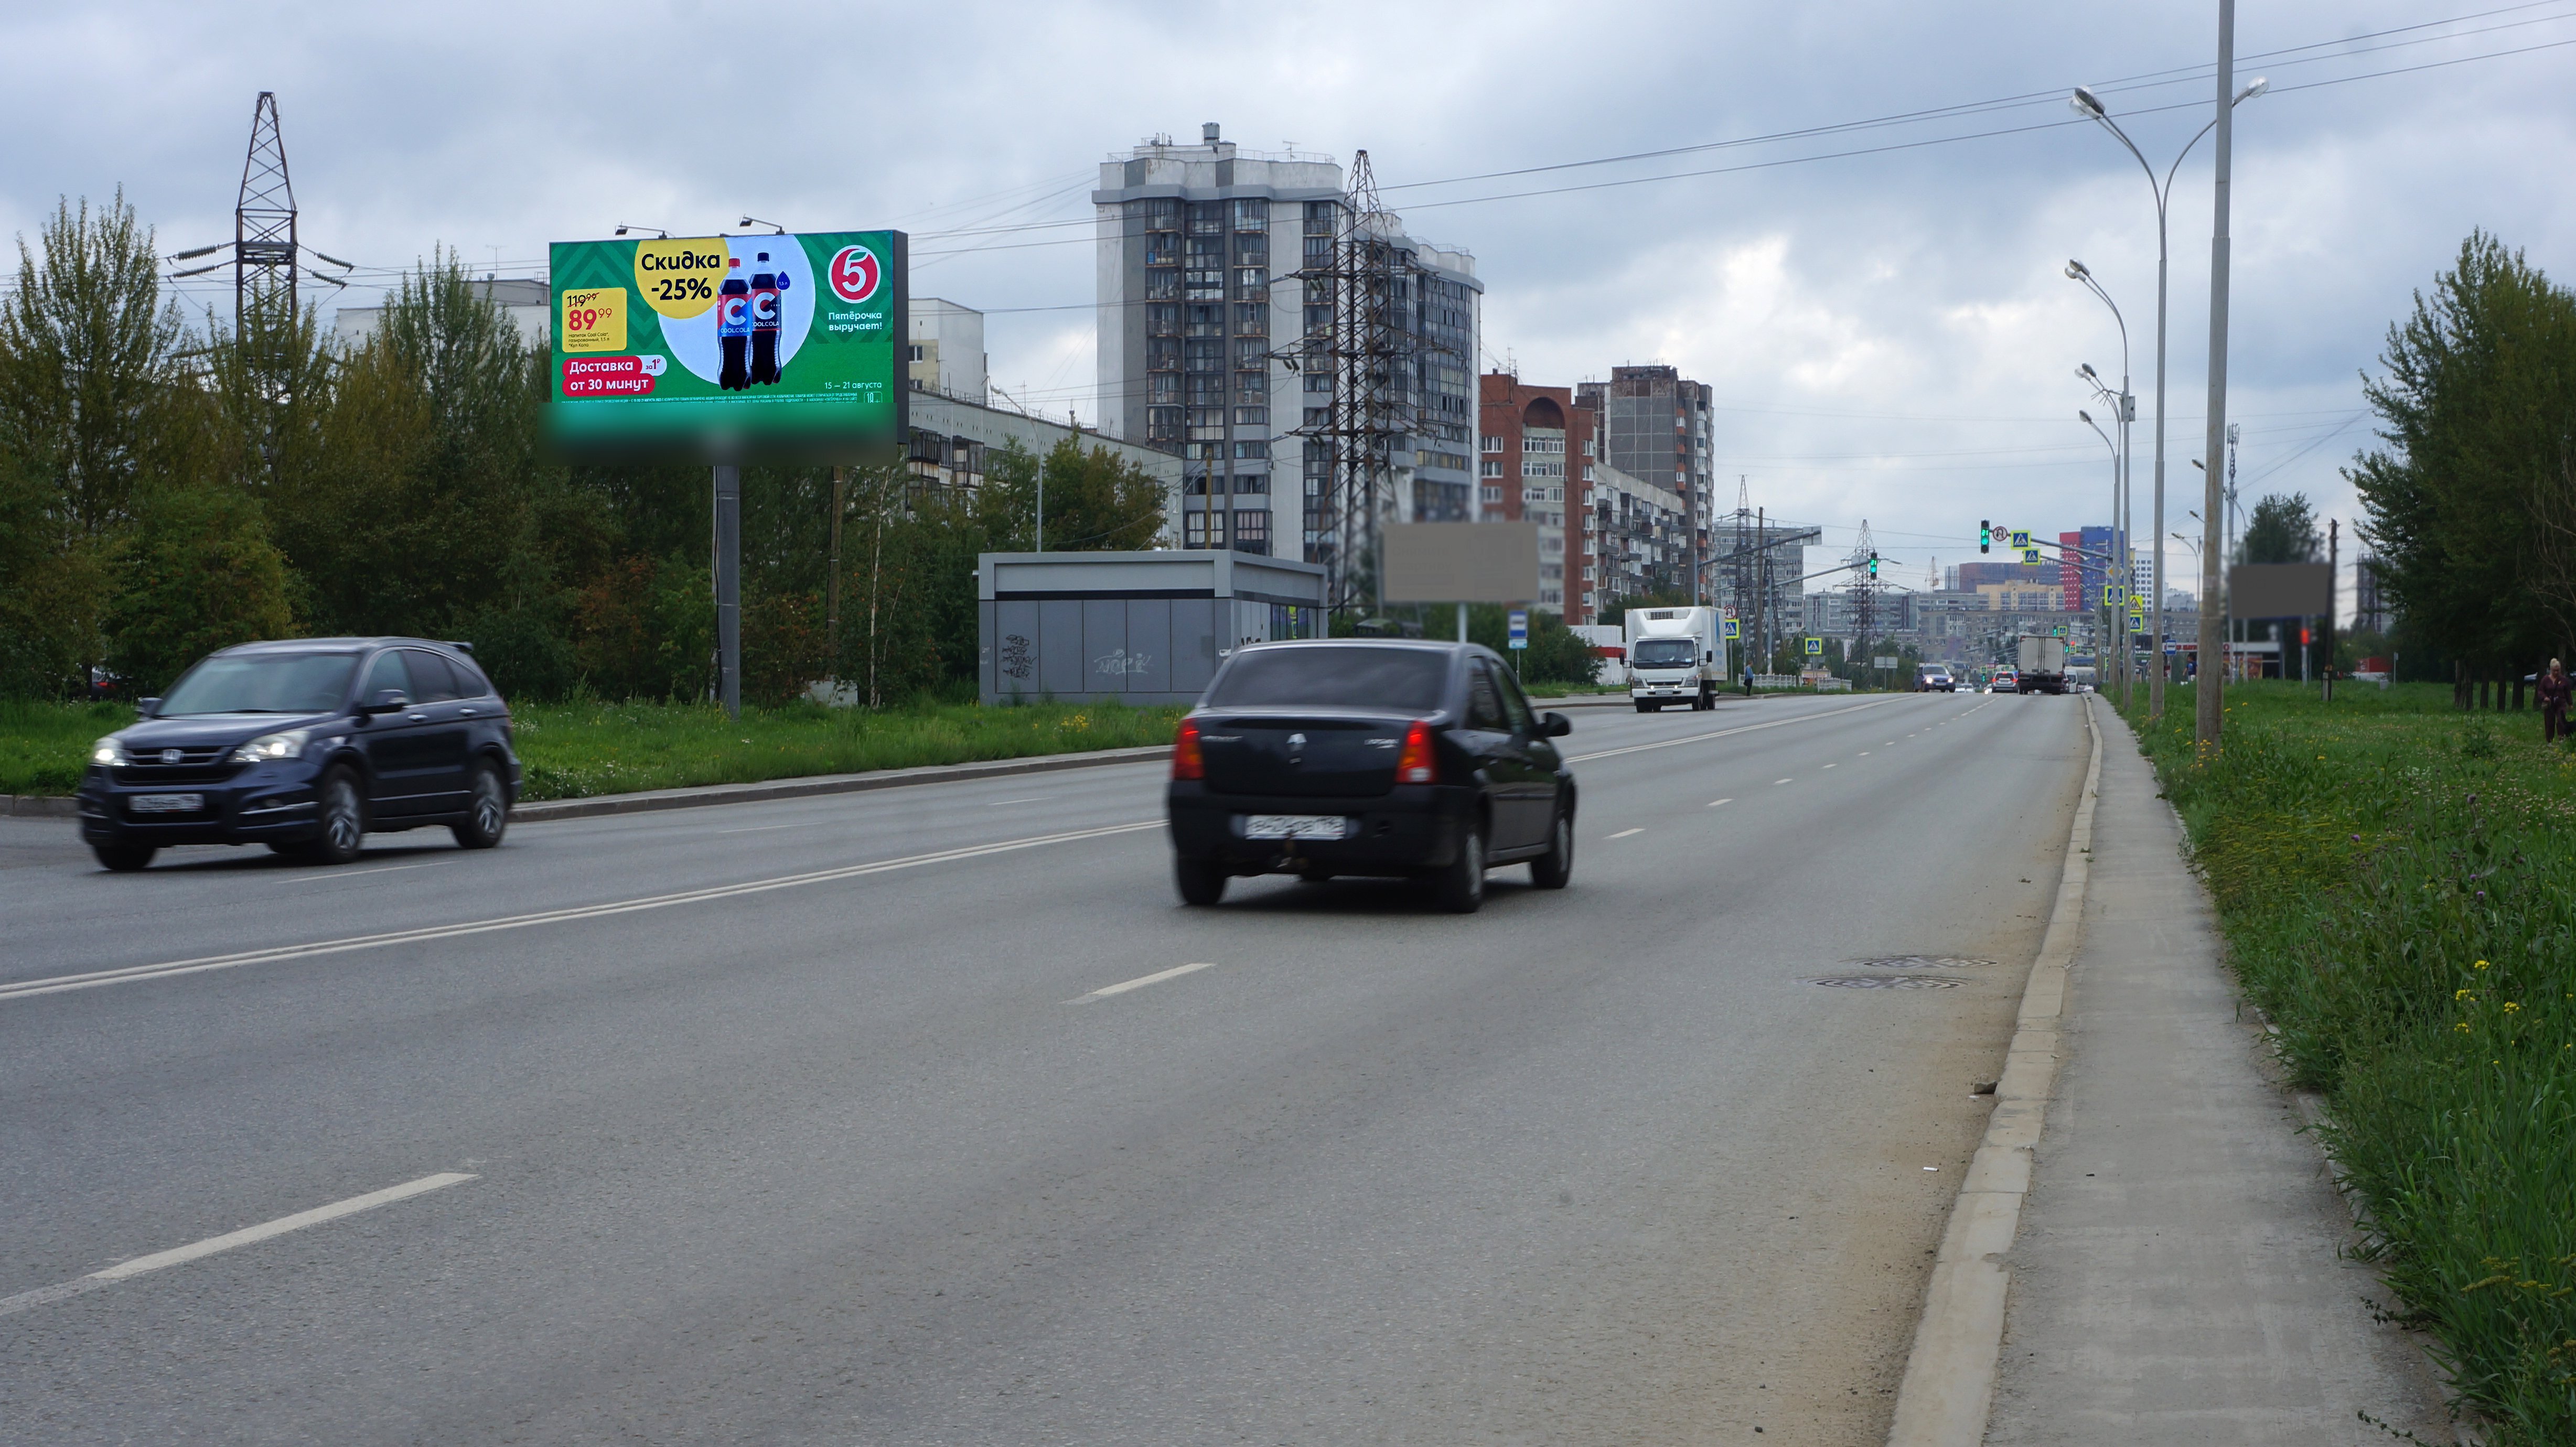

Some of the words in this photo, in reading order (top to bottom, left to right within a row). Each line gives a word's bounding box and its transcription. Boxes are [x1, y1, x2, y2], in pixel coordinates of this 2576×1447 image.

[641, 251, 720, 271] Скидка
[842, 250, 868, 293] 5
[651, 277, 712, 300] -25%
[829, 311, 882, 321] Пятёрочка
[829, 322, 882, 332] выручает!
[570, 361, 634, 374] Доставка
[570, 381, 585, 391] от
[588, 379, 603, 390] 30
[606, 379, 649, 392] минут
